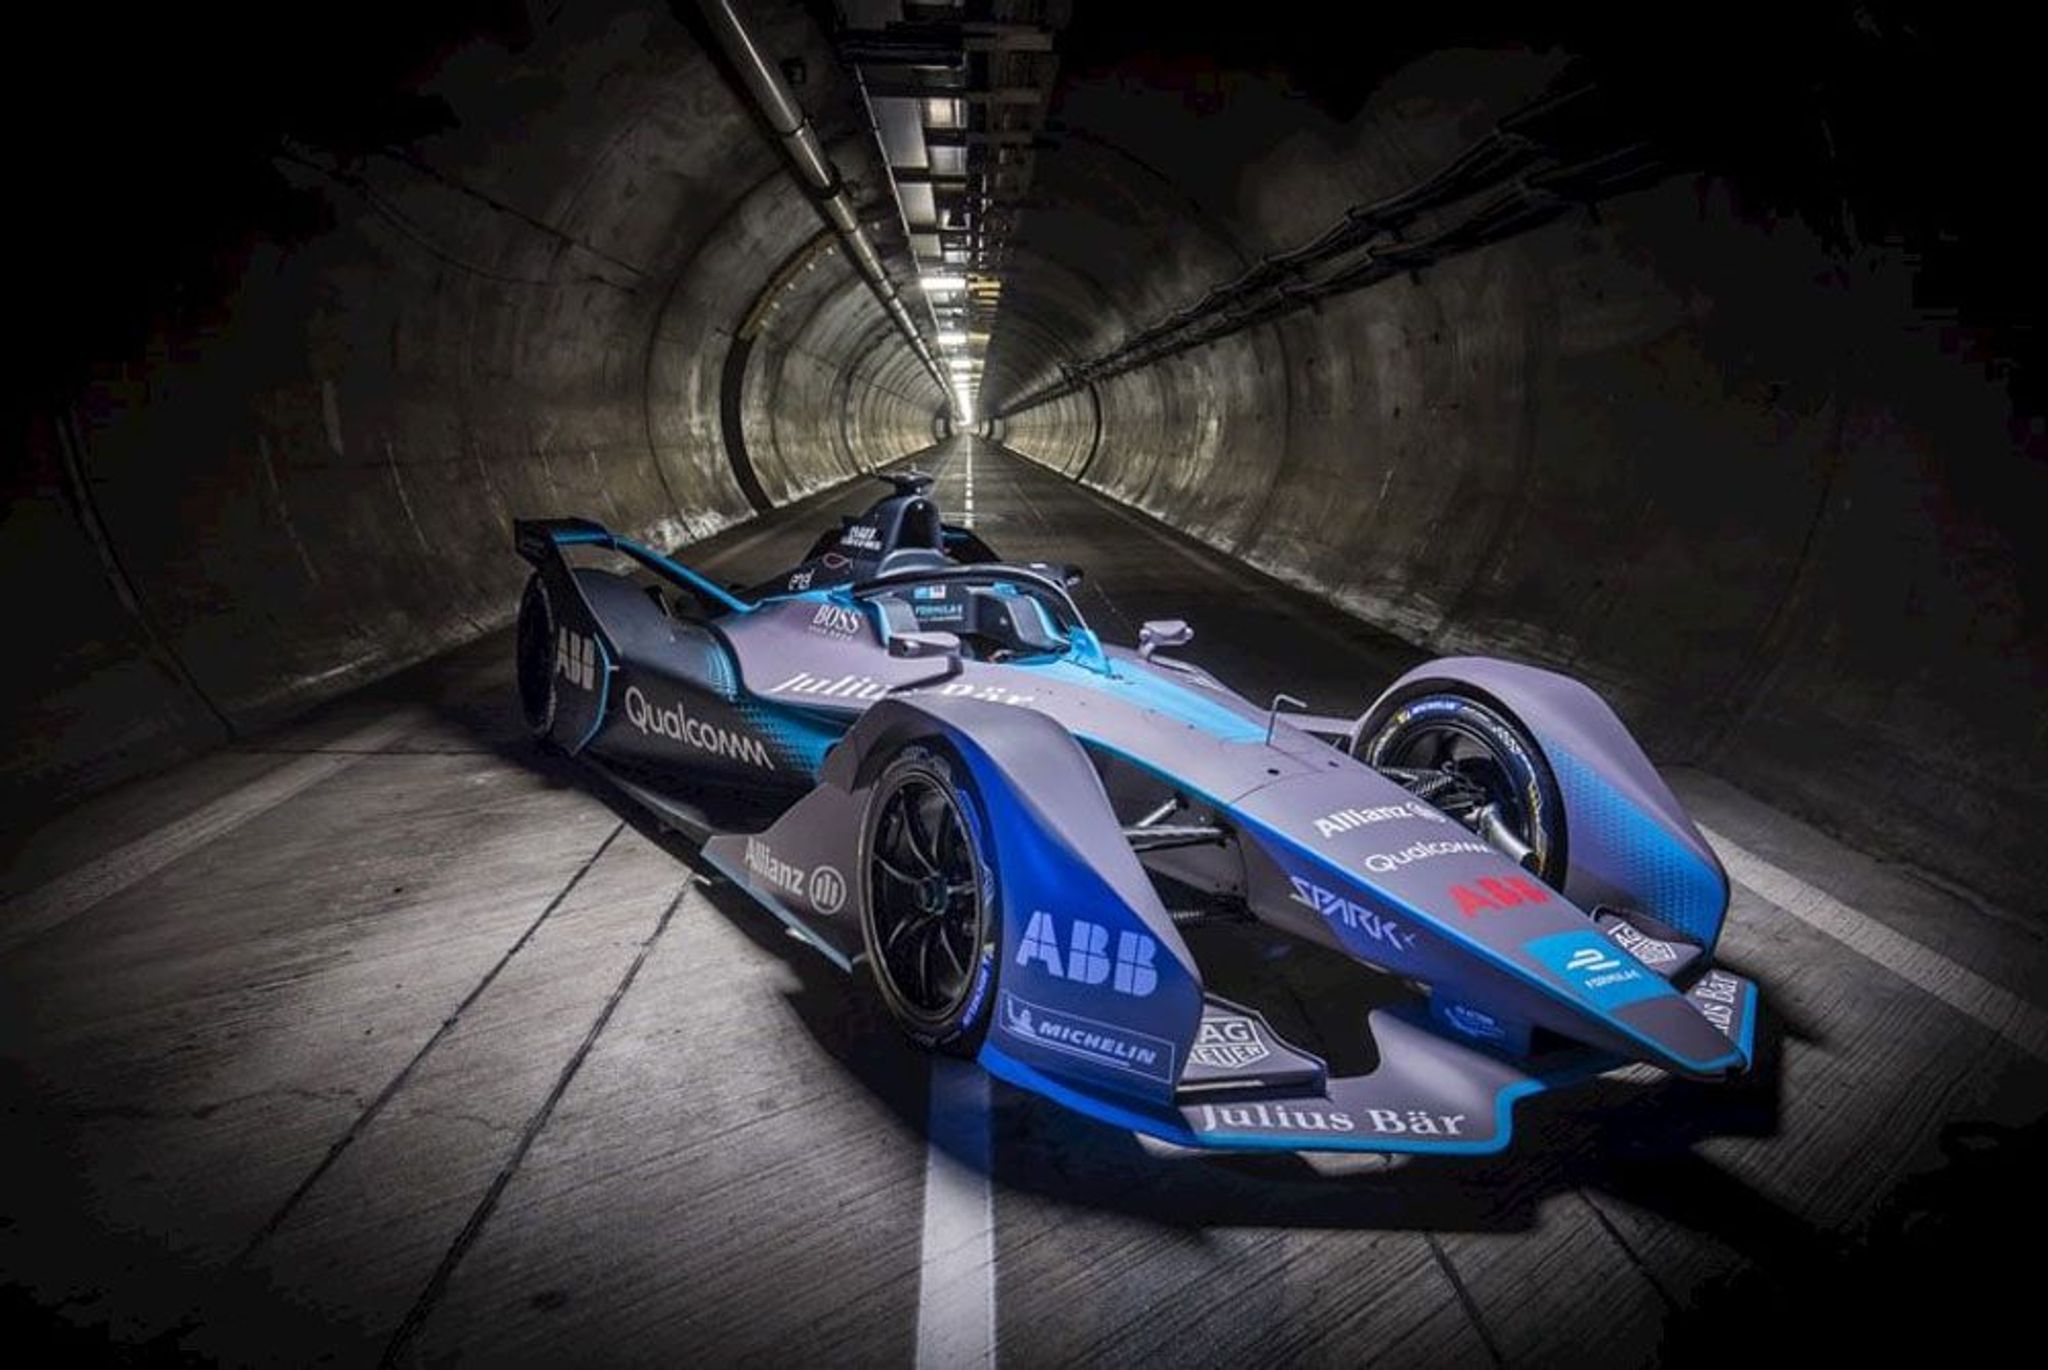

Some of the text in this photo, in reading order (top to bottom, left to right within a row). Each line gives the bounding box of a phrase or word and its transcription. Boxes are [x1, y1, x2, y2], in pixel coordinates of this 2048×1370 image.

[812, 604, 861, 633] BOSS
[556, 626, 595, 690] ABB
[624, 686, 775, 770] Qualcomm
[1314, 805, 1413, 838] Allianz
[745, 836, 804, 896] Allianz
[1290, 876, 1402, 950] SPARK
[1450, 875, 1548, 918] ABB
[1016, 911, 1157, 997] ABB
[1040, 1021, 1157, 1065] MICHELIN
[1200, 1023, 1249, 1043] AG
[1200, 1104, 1466, 1135] Julius Bär
